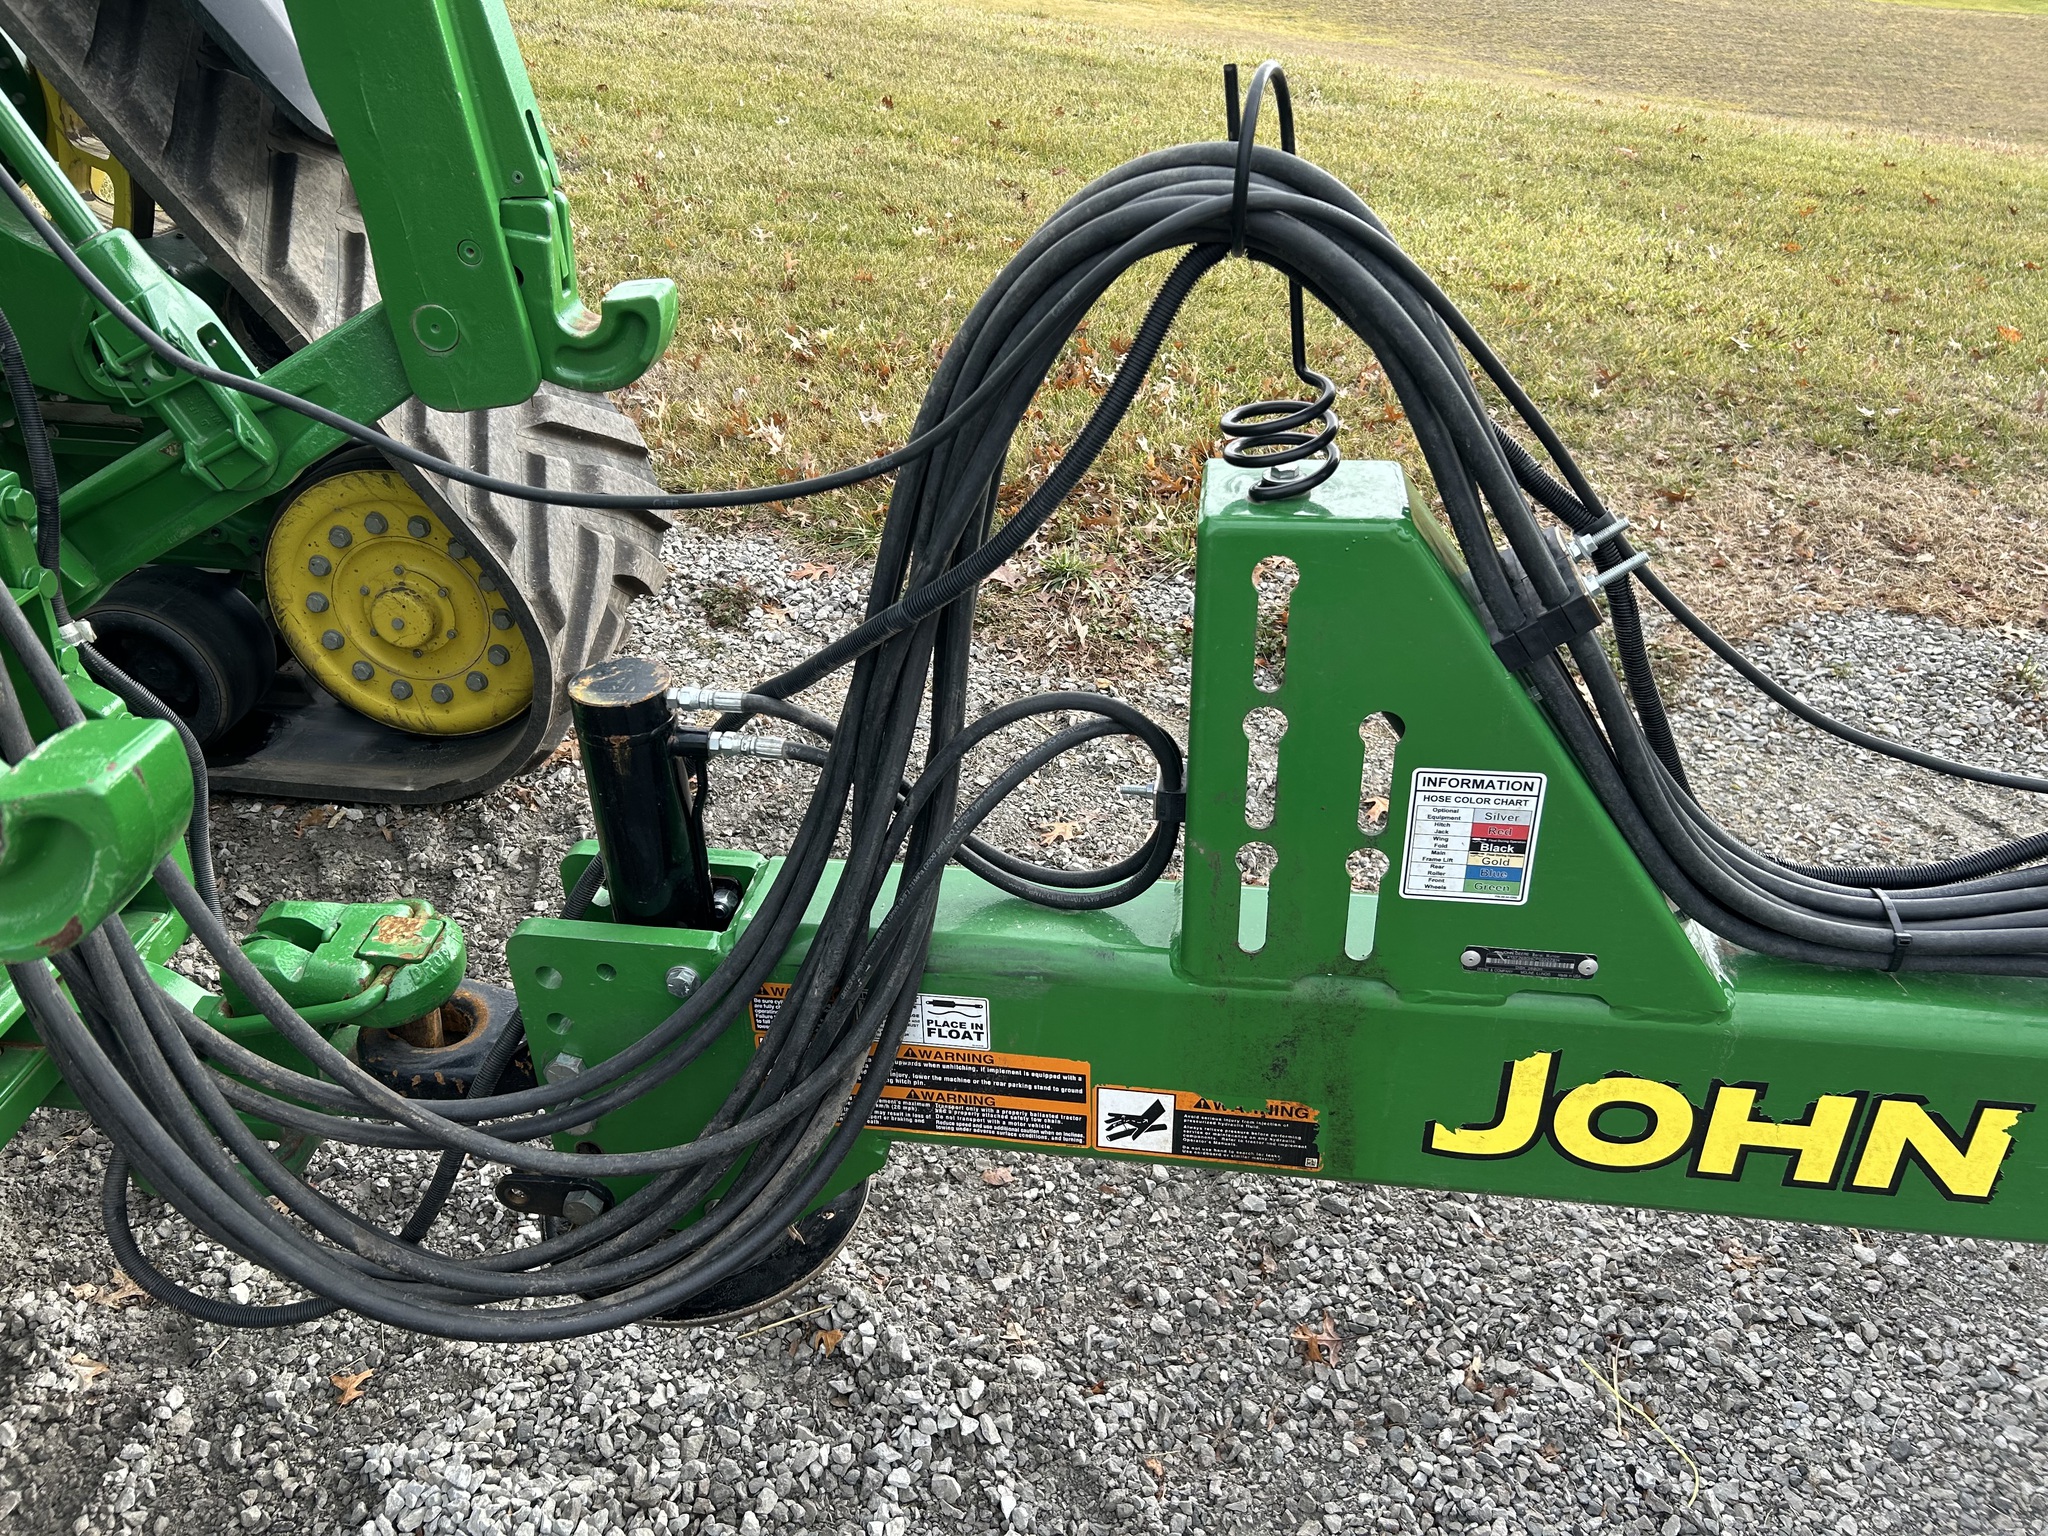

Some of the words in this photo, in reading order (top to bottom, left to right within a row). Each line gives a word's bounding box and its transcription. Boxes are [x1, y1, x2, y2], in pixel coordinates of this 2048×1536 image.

[1422, 776, 1535, 792] INFORMATION
[970, 797, 984, 812] Type
[1423, 794, 1451, 803] HOSE
[1454, 795, 1491, 804] COLOR
[1493, 797, 1529, 806] CHART
[1484, 812, 1519, 822] Silver
[1487, 826, 1512, 836] Red
[1480, 842, 1514, 853] Black
[1481, 856, 1510, 866] Gold
[1478, 867, 1508, 879] Blue
[1473, 881, 1510, 892] Green
[926, 1019, 966, 1028] PLACE
[970, 1022, 983, 1030] IN
[926, 1027, 984, 1040] FLOAT
[917, 1049, 994, 1064] WARNING
[941, 1063, 978, 1072] unhitching,
[987, 1067, 1021, 1076] implement
[1030, 1071, 1060, 1079] equipped
[1007, 1082, 1032, 1090] parking
[1060, 1086, 1082, 1094] ground
[919, 1090, 995, 1106] WARNING
[935, 1102, 963, 1110] Transport
[1001, 1109, 1027, 1117] properly
[1029, 1111, 1058, 1119] ballasted
[1212, 1101, 1309, 1119] WNING
[956, 1115, 984, 1124] transport
[1422, 1049, 2036, 1204] JOHN
[1018, 1132, 1049, 1140] conditions,
